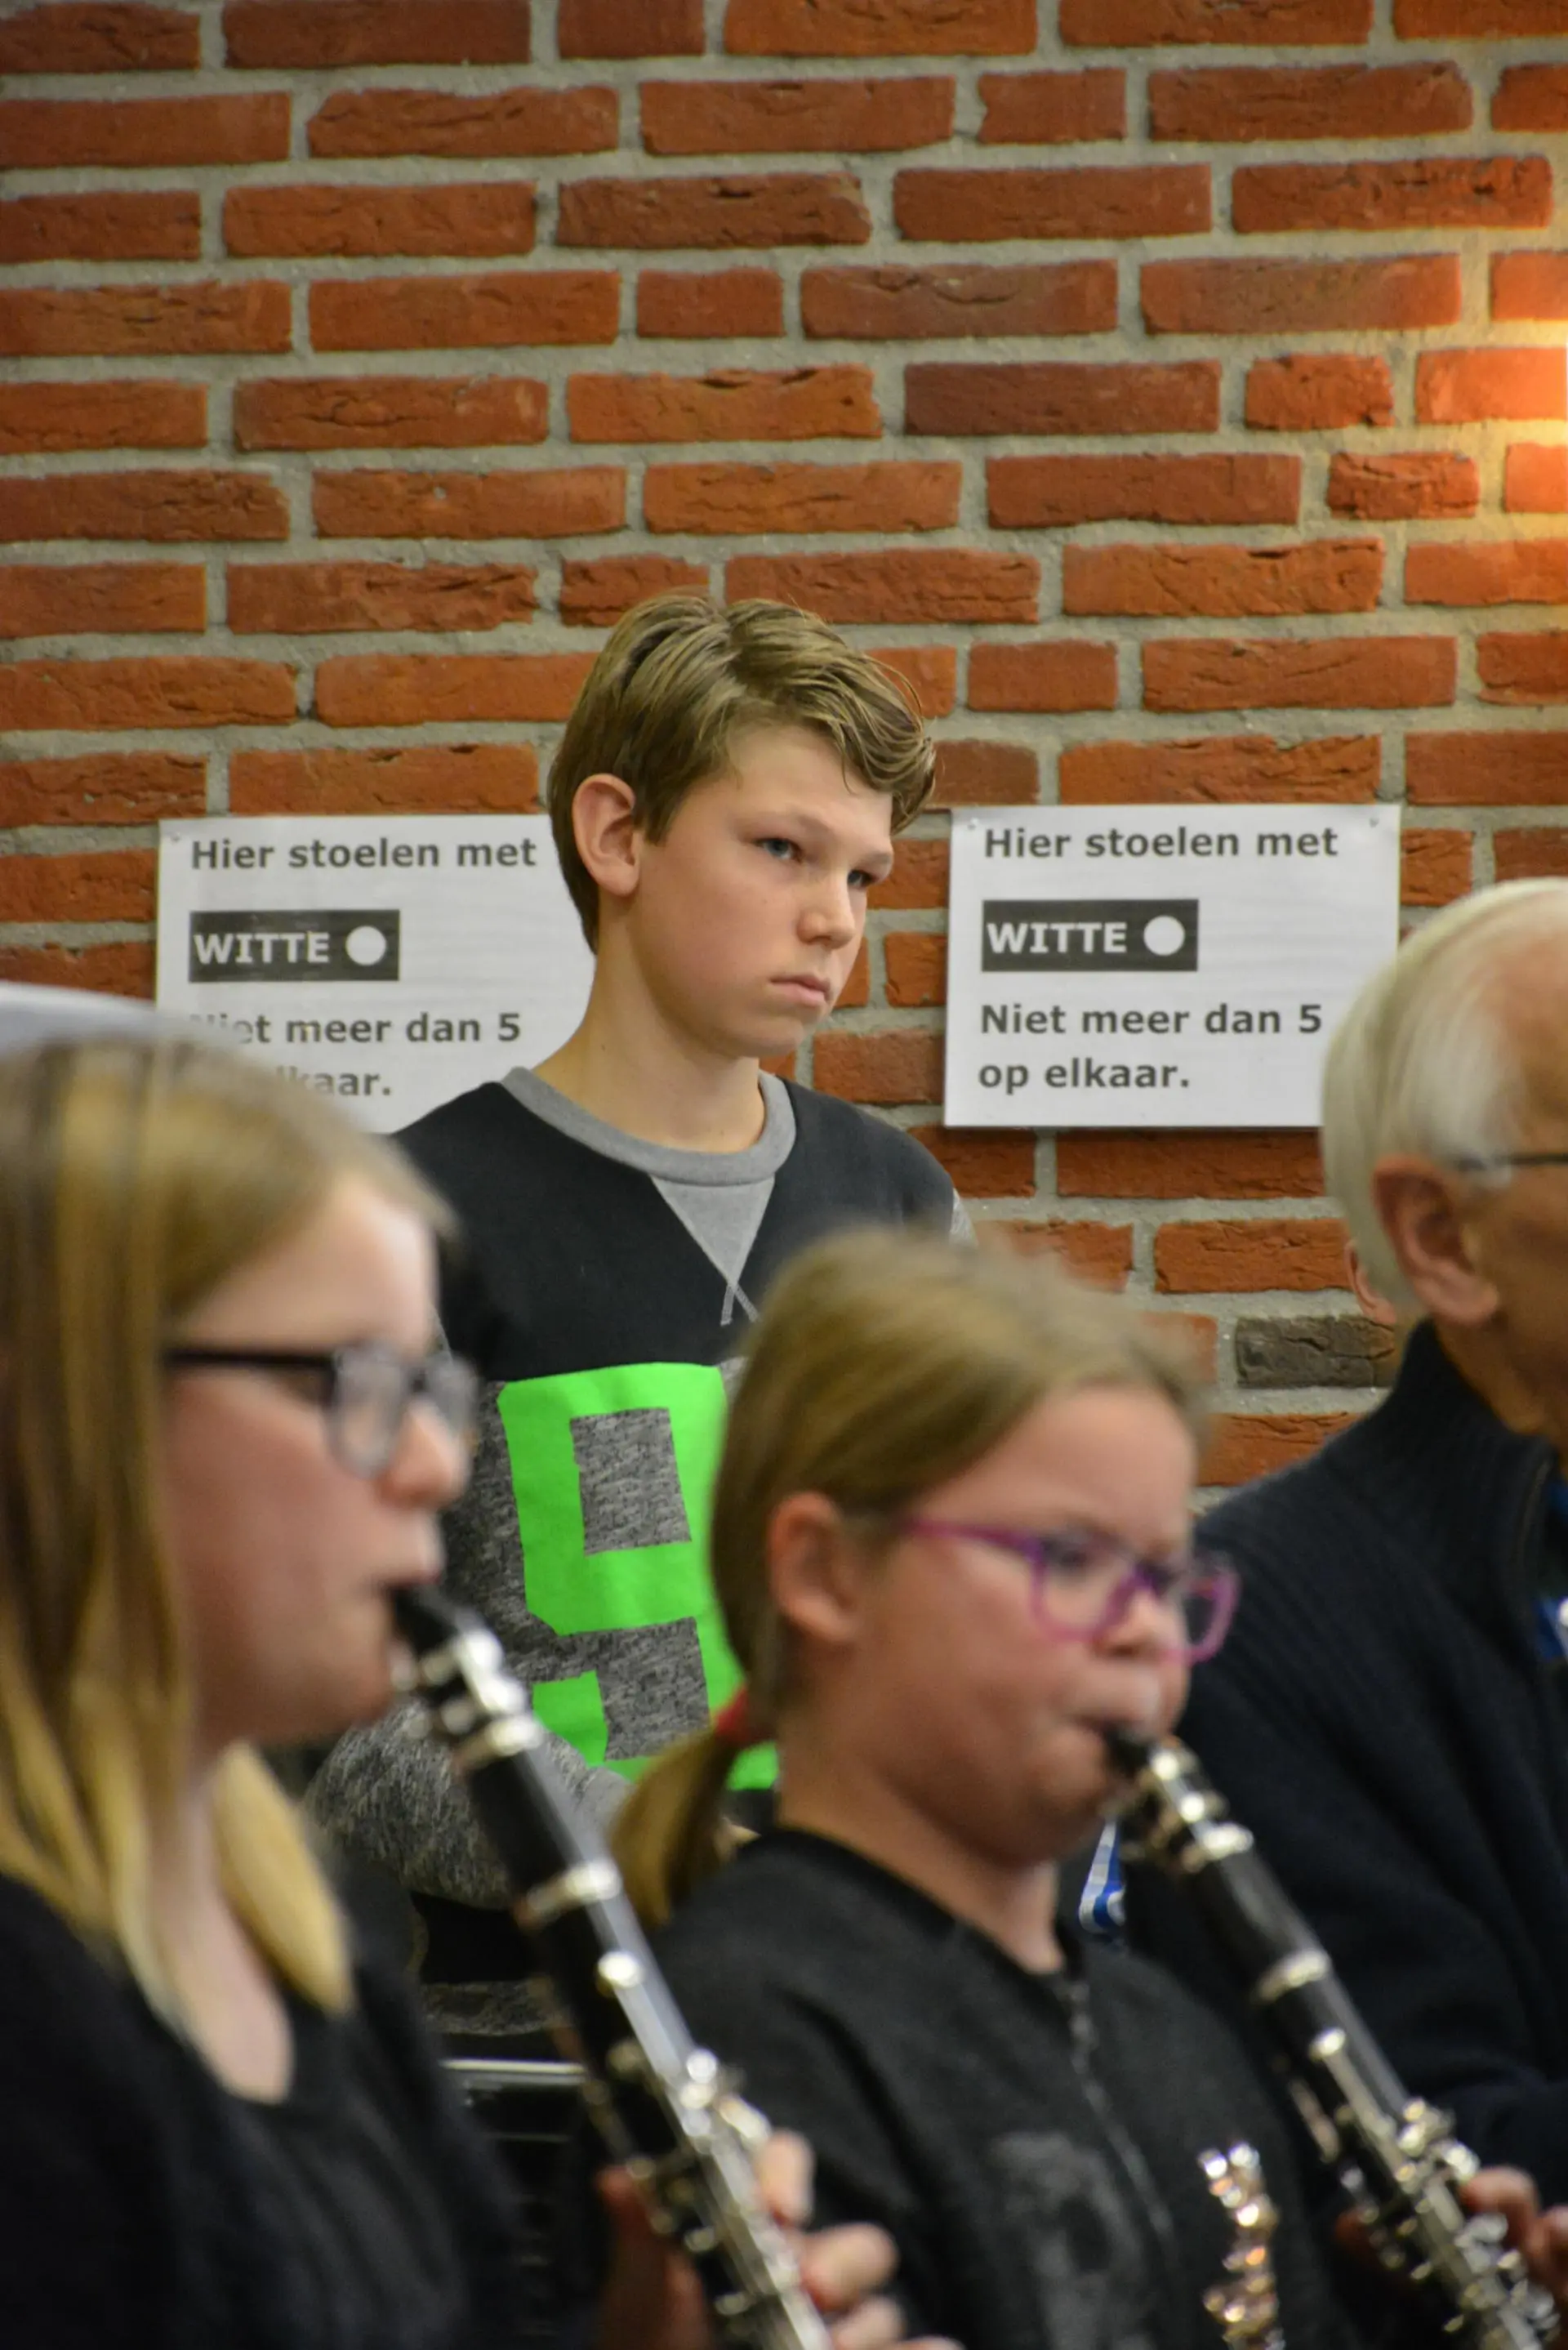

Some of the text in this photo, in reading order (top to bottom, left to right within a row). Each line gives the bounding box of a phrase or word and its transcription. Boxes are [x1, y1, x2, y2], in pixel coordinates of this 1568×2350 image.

[193, 837, 537, 869] Hier stoelen met
[985, 826, 1338, 857] Hier stoelen met
[194, 932, 330, 964] WITTE
[987, 922, 1128, 954] WITTE
[189, 1012, 521, 1044] et meer dan 5
[981, 1002, 1322, 1034] Niet meer dan 5
[276, 1065, 392, 1096] kaar.
[978, 1057, 1190, 1095] op elkaar.
